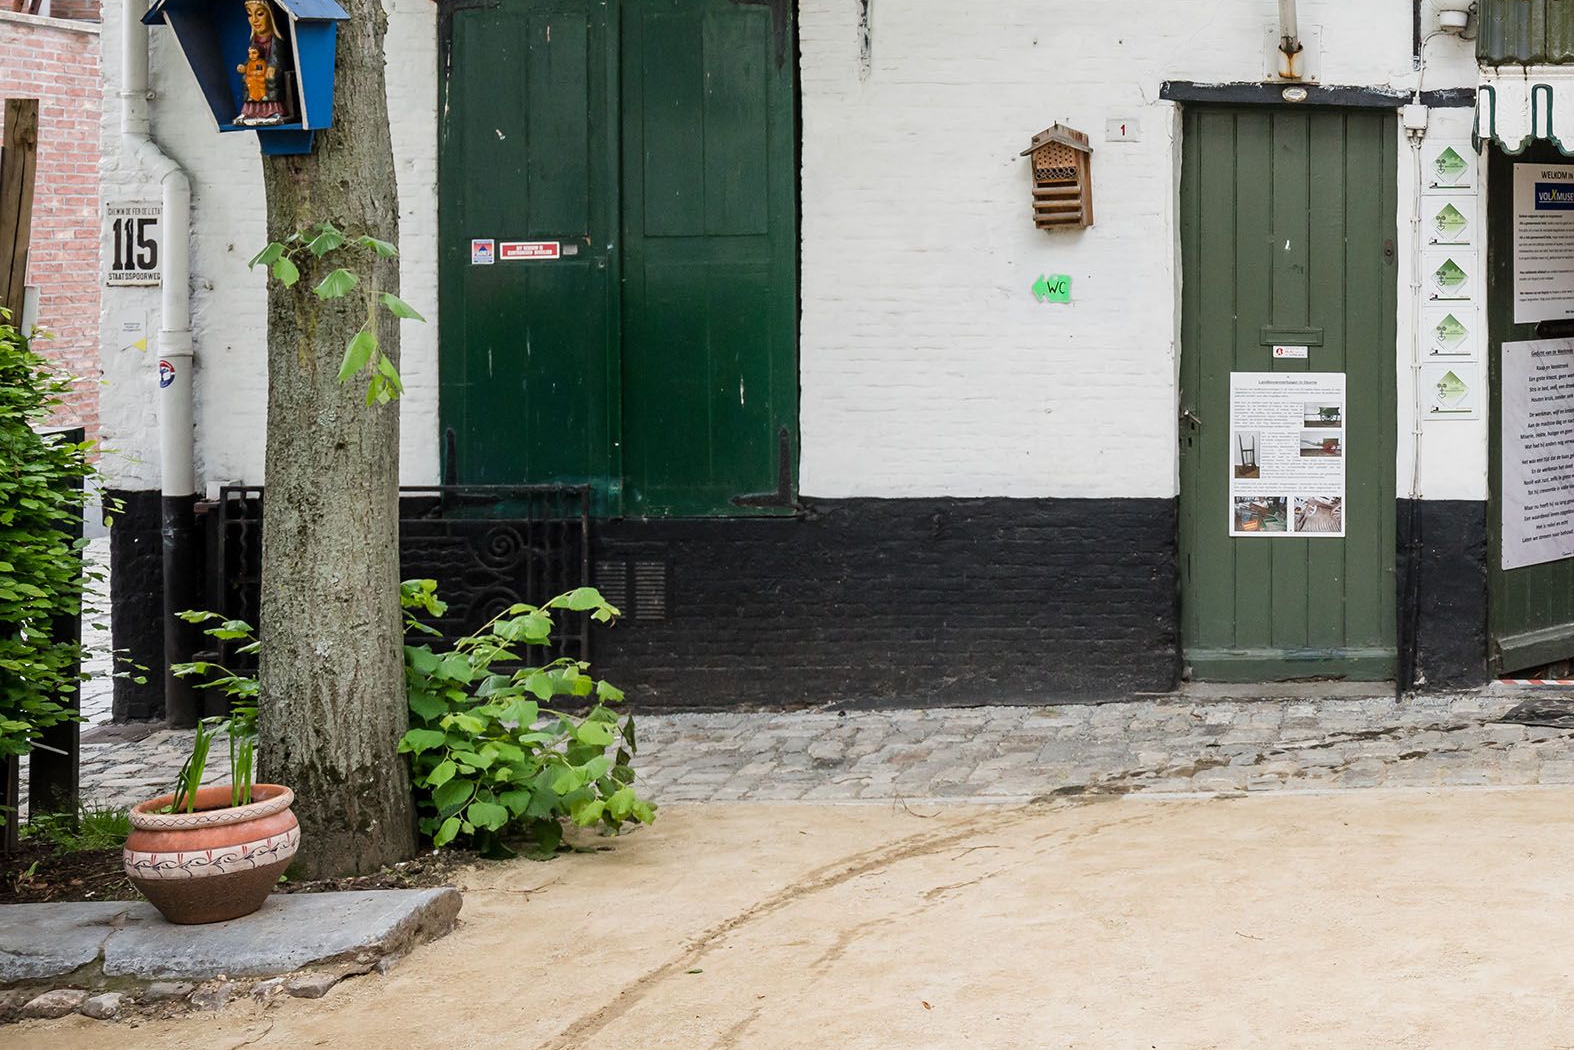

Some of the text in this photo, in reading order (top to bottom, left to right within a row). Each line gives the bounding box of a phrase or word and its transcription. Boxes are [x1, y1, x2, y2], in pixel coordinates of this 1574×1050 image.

[1121, 125, 1125, 136] 1
[1541, 171, 1567, 179] WELKOM
[113, 218, 157, 270] 115
[109, 272, 160, 280] STAATSSPOORWEG
[1047, 282, 1066, 294] WC
